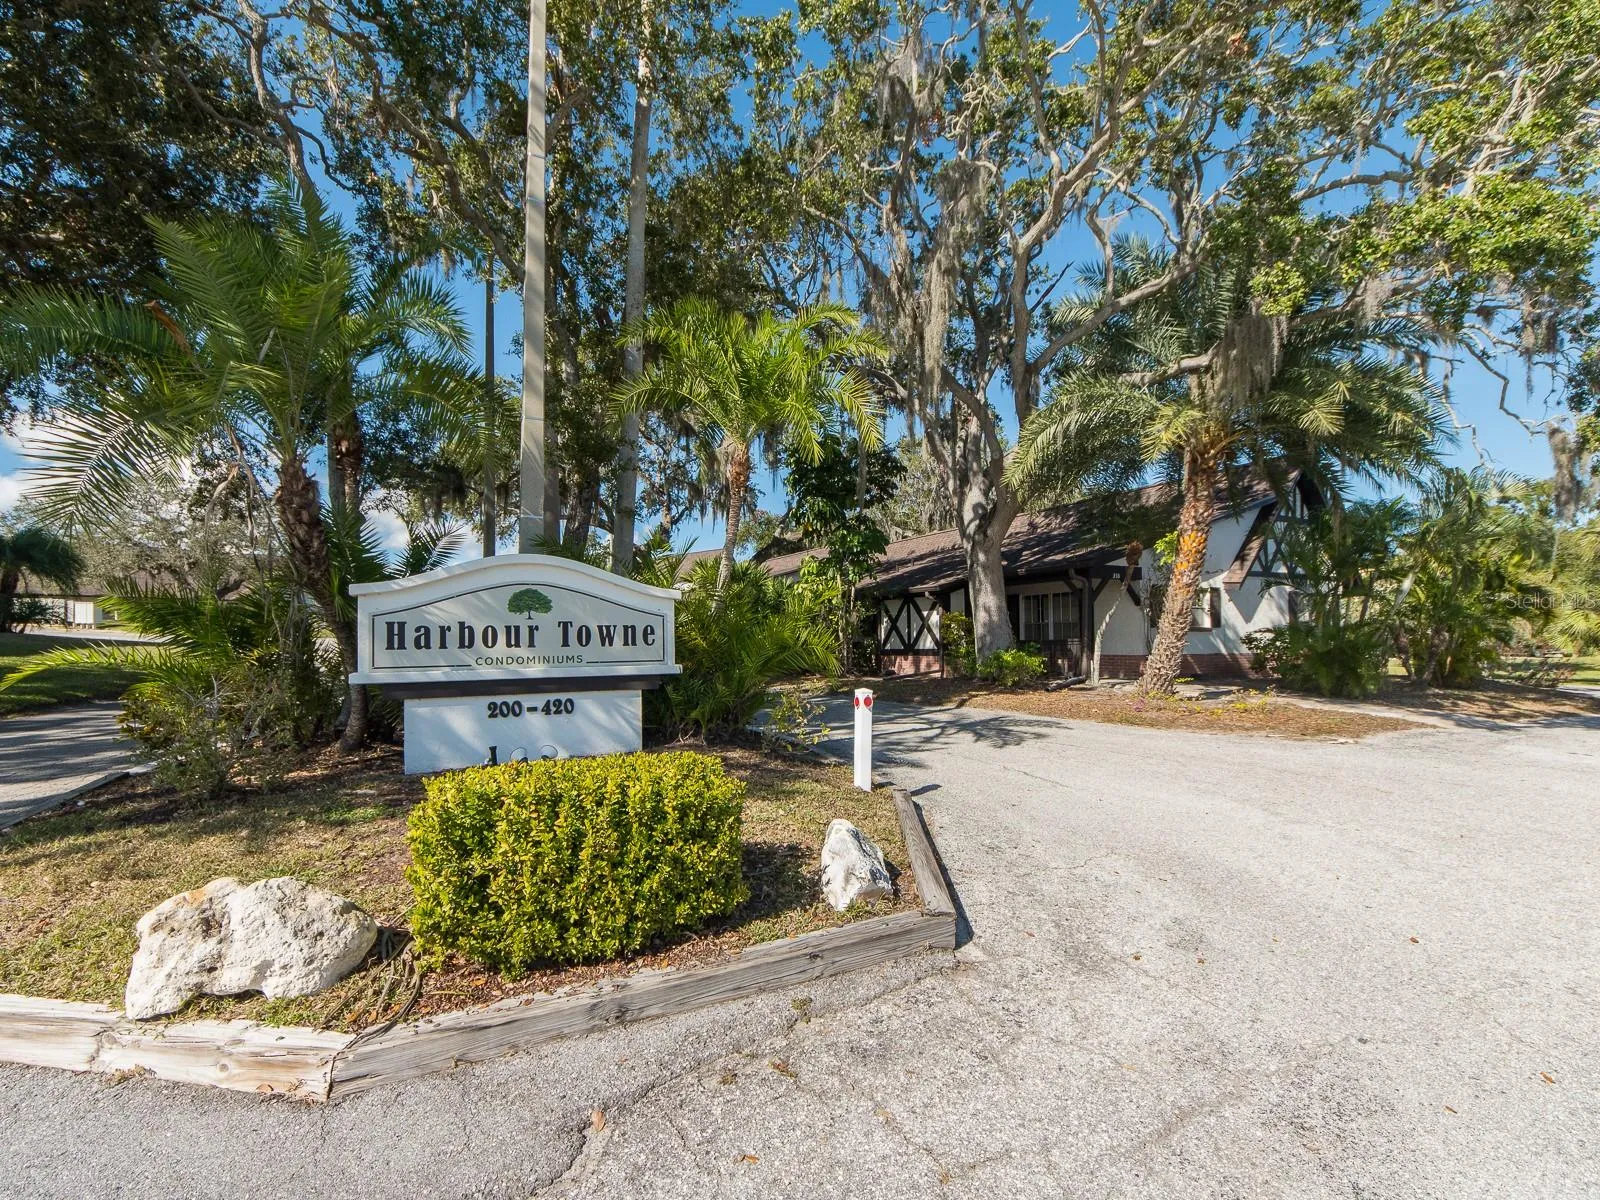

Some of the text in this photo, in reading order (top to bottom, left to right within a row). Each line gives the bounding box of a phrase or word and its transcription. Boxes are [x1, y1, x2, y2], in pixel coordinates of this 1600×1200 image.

[384, 620, 657, 651] Harbour Towne
[475, 654, 584, 667] CONDOMINIUMS
